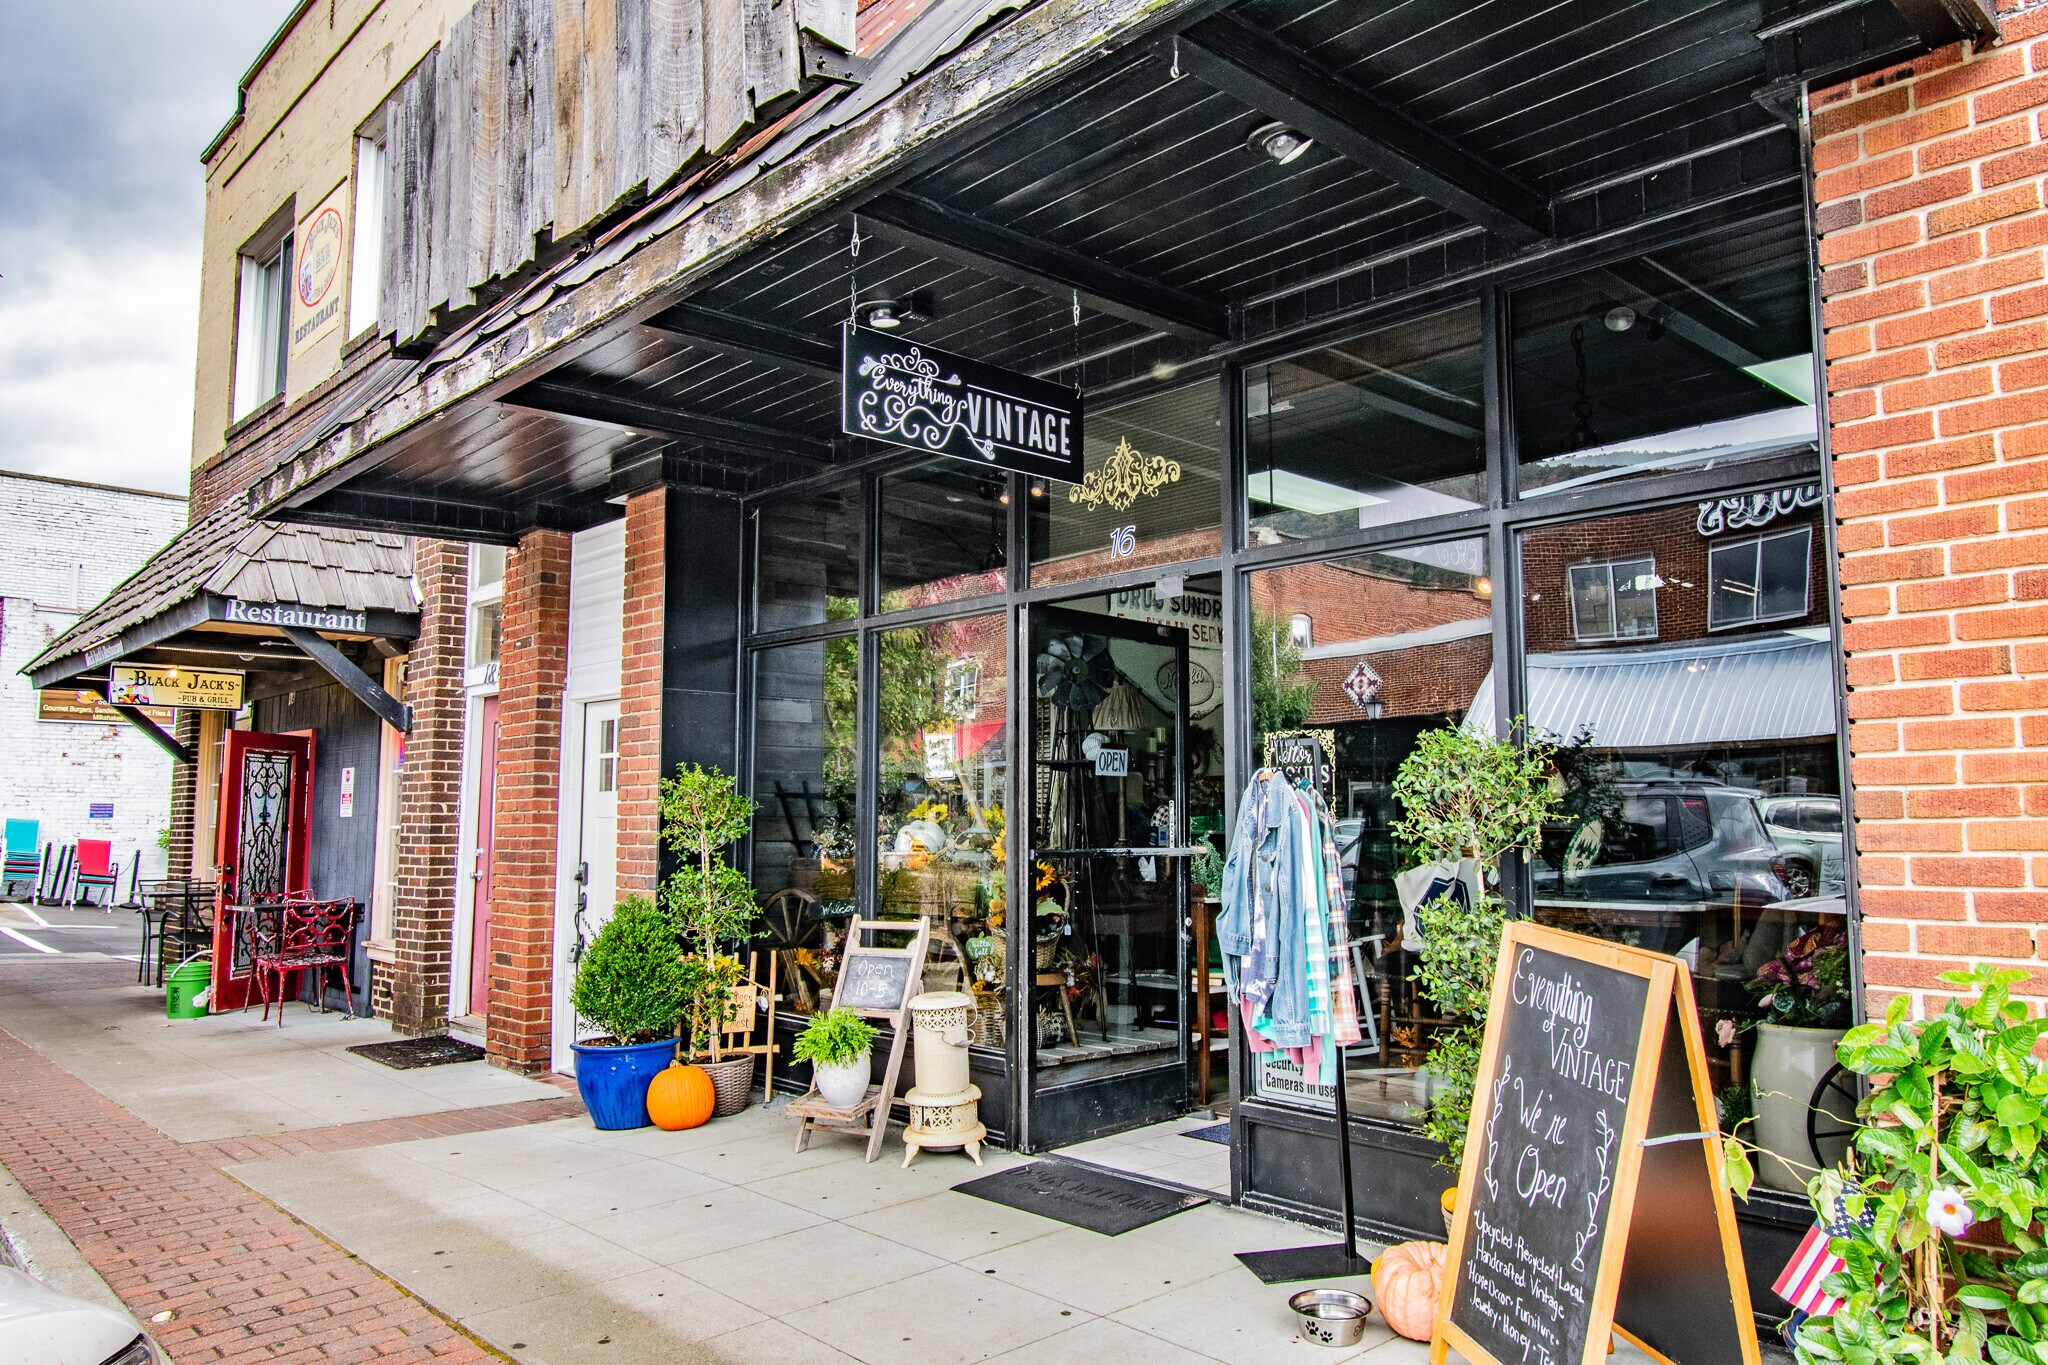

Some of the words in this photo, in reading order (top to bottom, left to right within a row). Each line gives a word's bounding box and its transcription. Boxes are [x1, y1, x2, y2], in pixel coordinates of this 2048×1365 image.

[295, 296, 340, 344] RESTAURANT
[871, 364, 957, 423] Everything
[966, 391, 1071, 456] VINTAGE
[1110, 525, 1136, 559] 16
[227, 599, 366, 632] Restaurant
[484, 662, 497, 685] 18
[42, 704, 69, 713] Gourmet
[152, 709, 166, 717] Fries
[182, 695, 197, 703] PUB
[207, 696, 230, 704] GRILL
[1098, 751, 1126, 772] OPEN
[855, 980, 888, 999] 10-5
[858, 959, 895, 979] Open
[1512, 947, 1593, 1049] Everything
[1265, 1071, 1304, 1093] Cameras
[1546, 1021, 1630, 1104] VINTAGE
[1513, 1076, 1568, 1145] We're
[1516, 1144, 1568, 1209] Open
[1475, 1210, 1514, 1249] Upcycled
[1516, 1236, 1556, 1282] Recycled
[1558, 1266, 1585, 1304] Local
[1475, 1234, 1526, 1288] Handcrafted
[1530, 1274, 1565, 1322] Vintage
[1502, 1313, 1531, 1362] Honey
